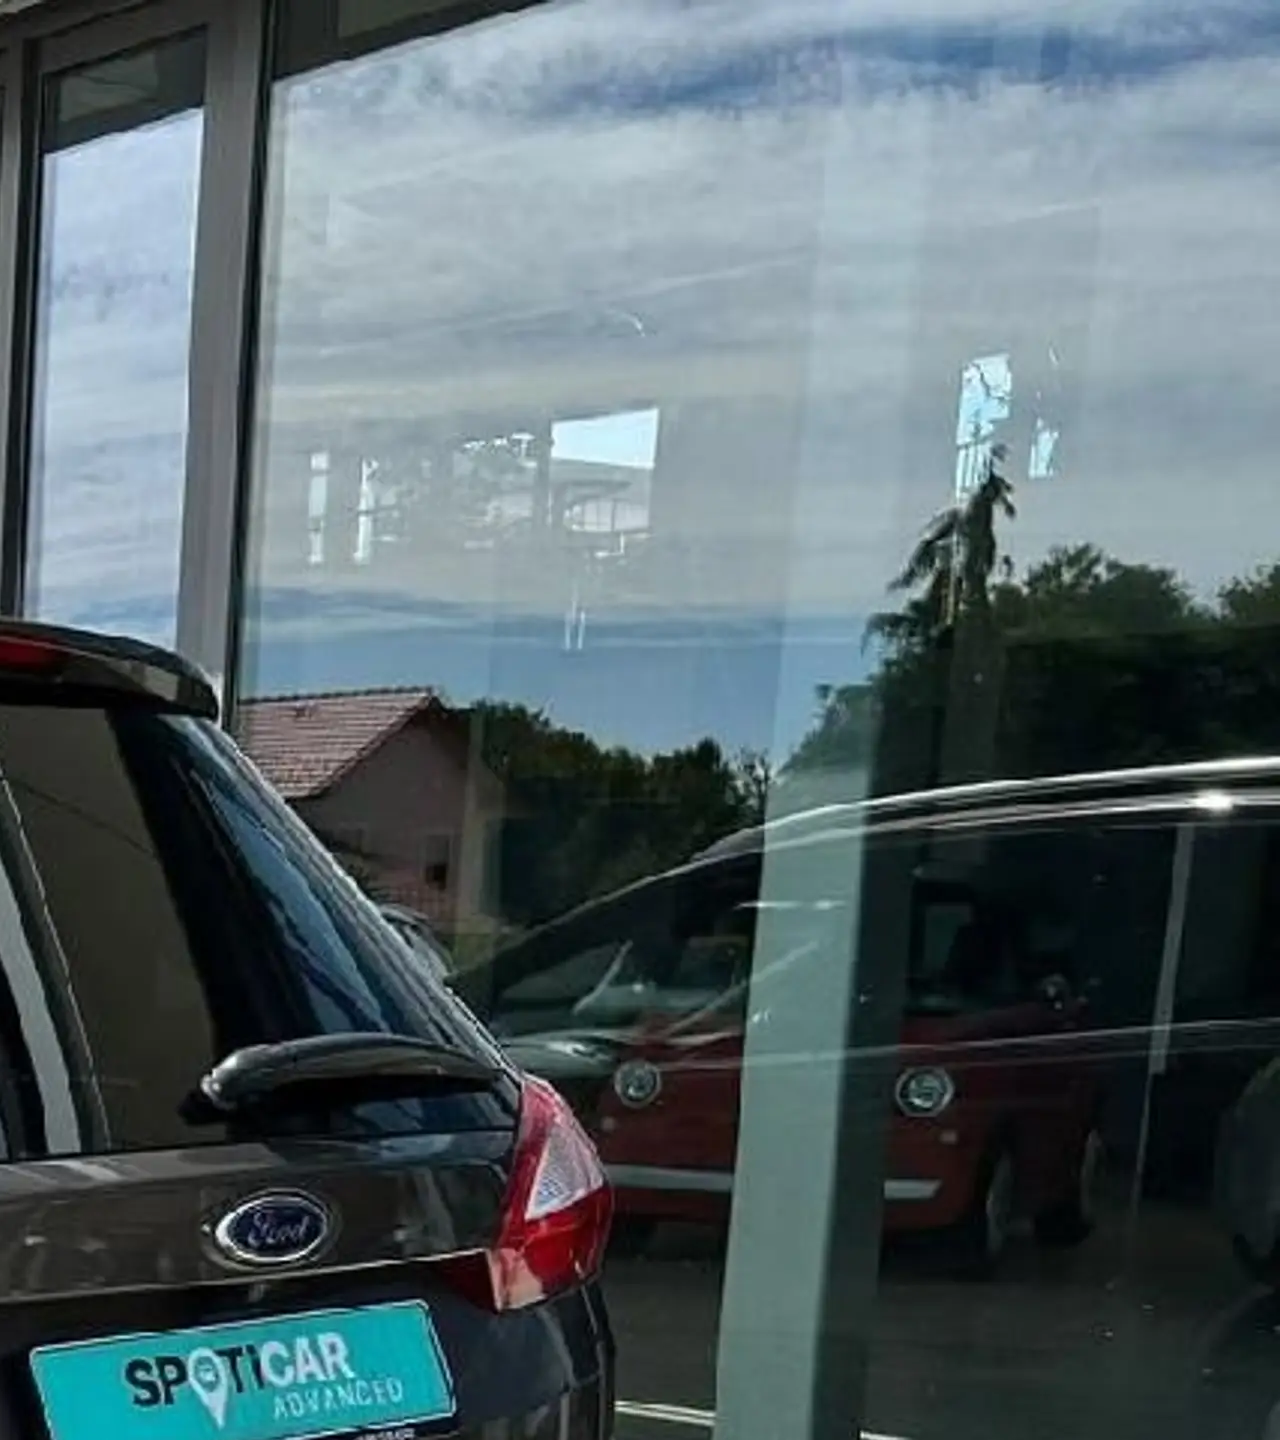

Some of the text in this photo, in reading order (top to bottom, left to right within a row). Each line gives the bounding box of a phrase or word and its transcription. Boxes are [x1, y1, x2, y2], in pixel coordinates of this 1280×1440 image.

[247, 1211, 310, 1249] Ford
[124, 1332, 354, 1429] SPOTICAR
[272, 1377, 404, 1421] ADVANCED
